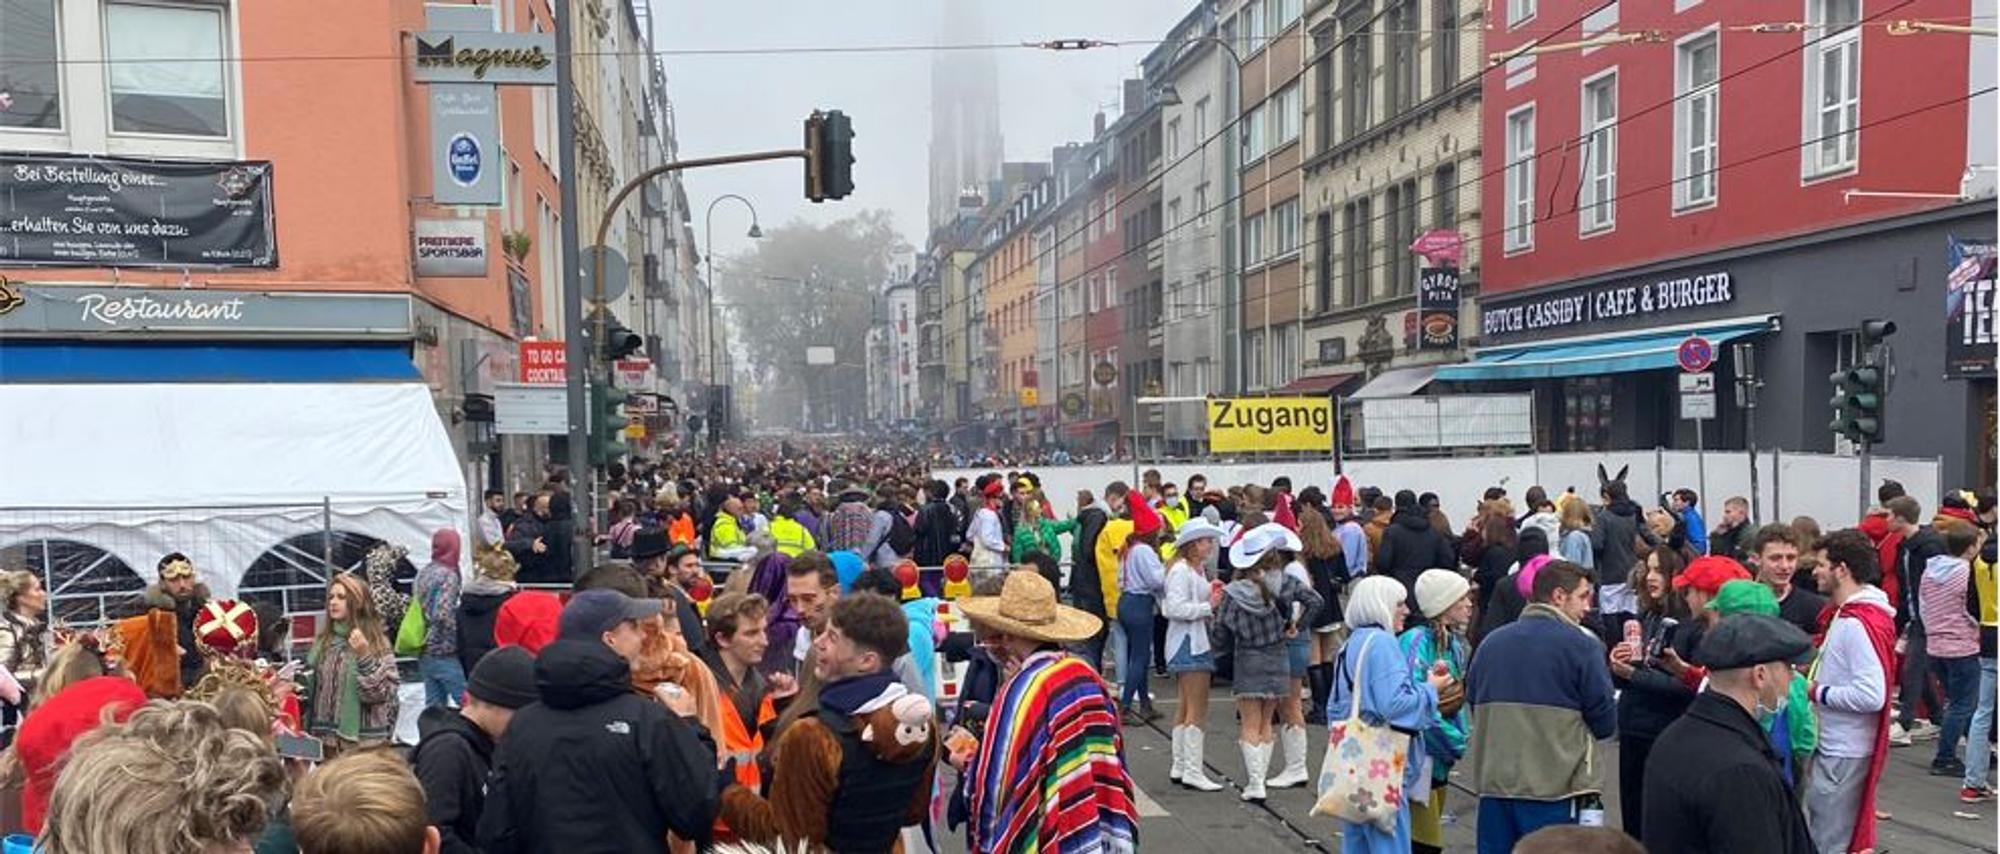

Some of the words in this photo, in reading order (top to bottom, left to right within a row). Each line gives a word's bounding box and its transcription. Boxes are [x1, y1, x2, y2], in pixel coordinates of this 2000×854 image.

[416, 35, 552, 79] Magnus
[14, 164, 41, 181] Bei
[43, 165, 121, 192] Bestellung
[71, 216, 95, 234] Sie
[97, 221, 122, 235] von
[124, 221, 149, 235] uns
[1422, 272, 1459, 291] GYROS
[1428, 290, 1453, 301] PITA
[76, 293, 244, 325] Restaurant
[1484, 306, 1524, 335] BUTCH
[1526, 295, 1585, 329] CASSIDY
[1596, 288, 1638, 319] CAFE
[1641, 284, 1655, 312] &
[1657, 271, 1733, 310] BURGER
[527, 349, 540, 363] TO
[540, 349, 554, 363] GO
[1213, 400, 1329, 434] Zugang
